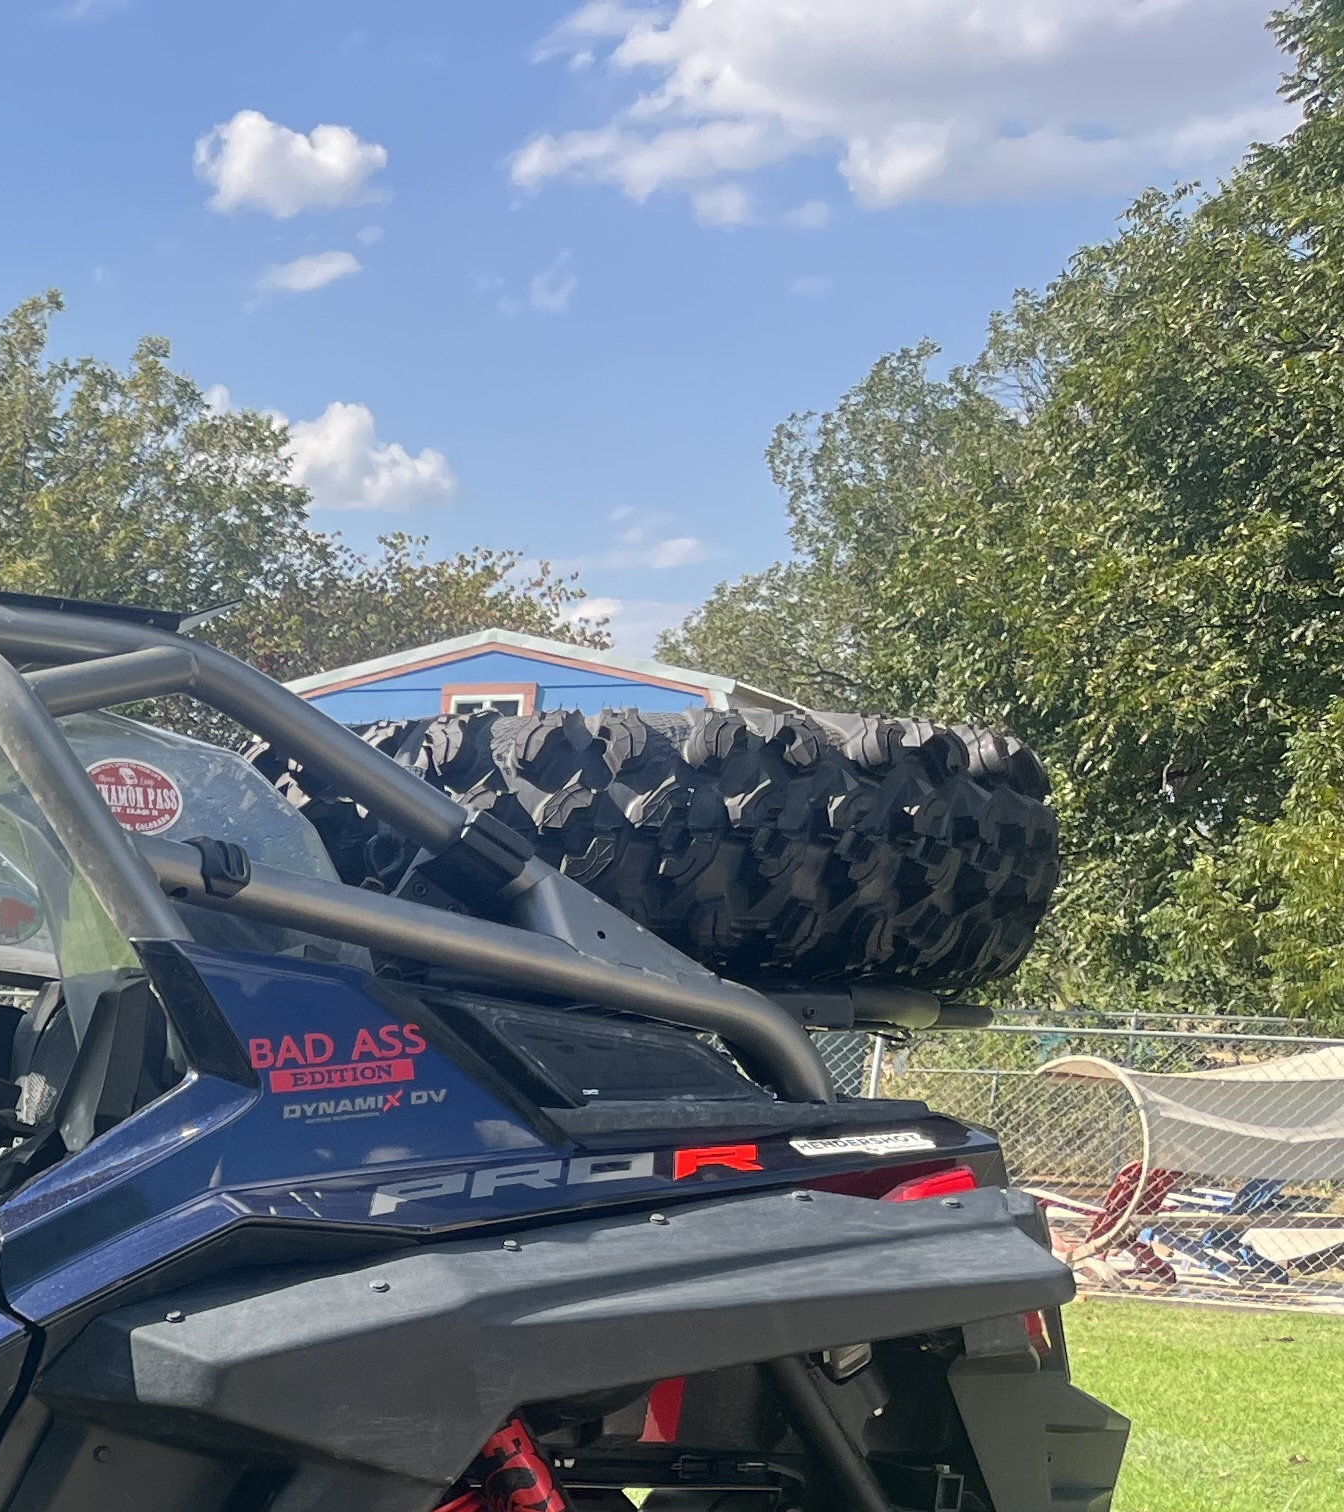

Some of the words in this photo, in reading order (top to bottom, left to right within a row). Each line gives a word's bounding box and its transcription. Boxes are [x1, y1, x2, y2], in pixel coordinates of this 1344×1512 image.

[146, 787, 178, 811] PASS
[135, 814, 172, 832] COLORADO
[249, 1033, 334, 1069] BAD
[351, 1023, 427, 1060] ASS
[290, 1063, 394, 1088] EDITION
[282, 1088, 404, 1120] DYNAMIX
[410, 1088, 447, 1105] DV
[795, 1134, 920, 1152] HENDERSHOT
[368, 1151, 655, 1218] PRO
[673, 1144, 765, 1182] R
